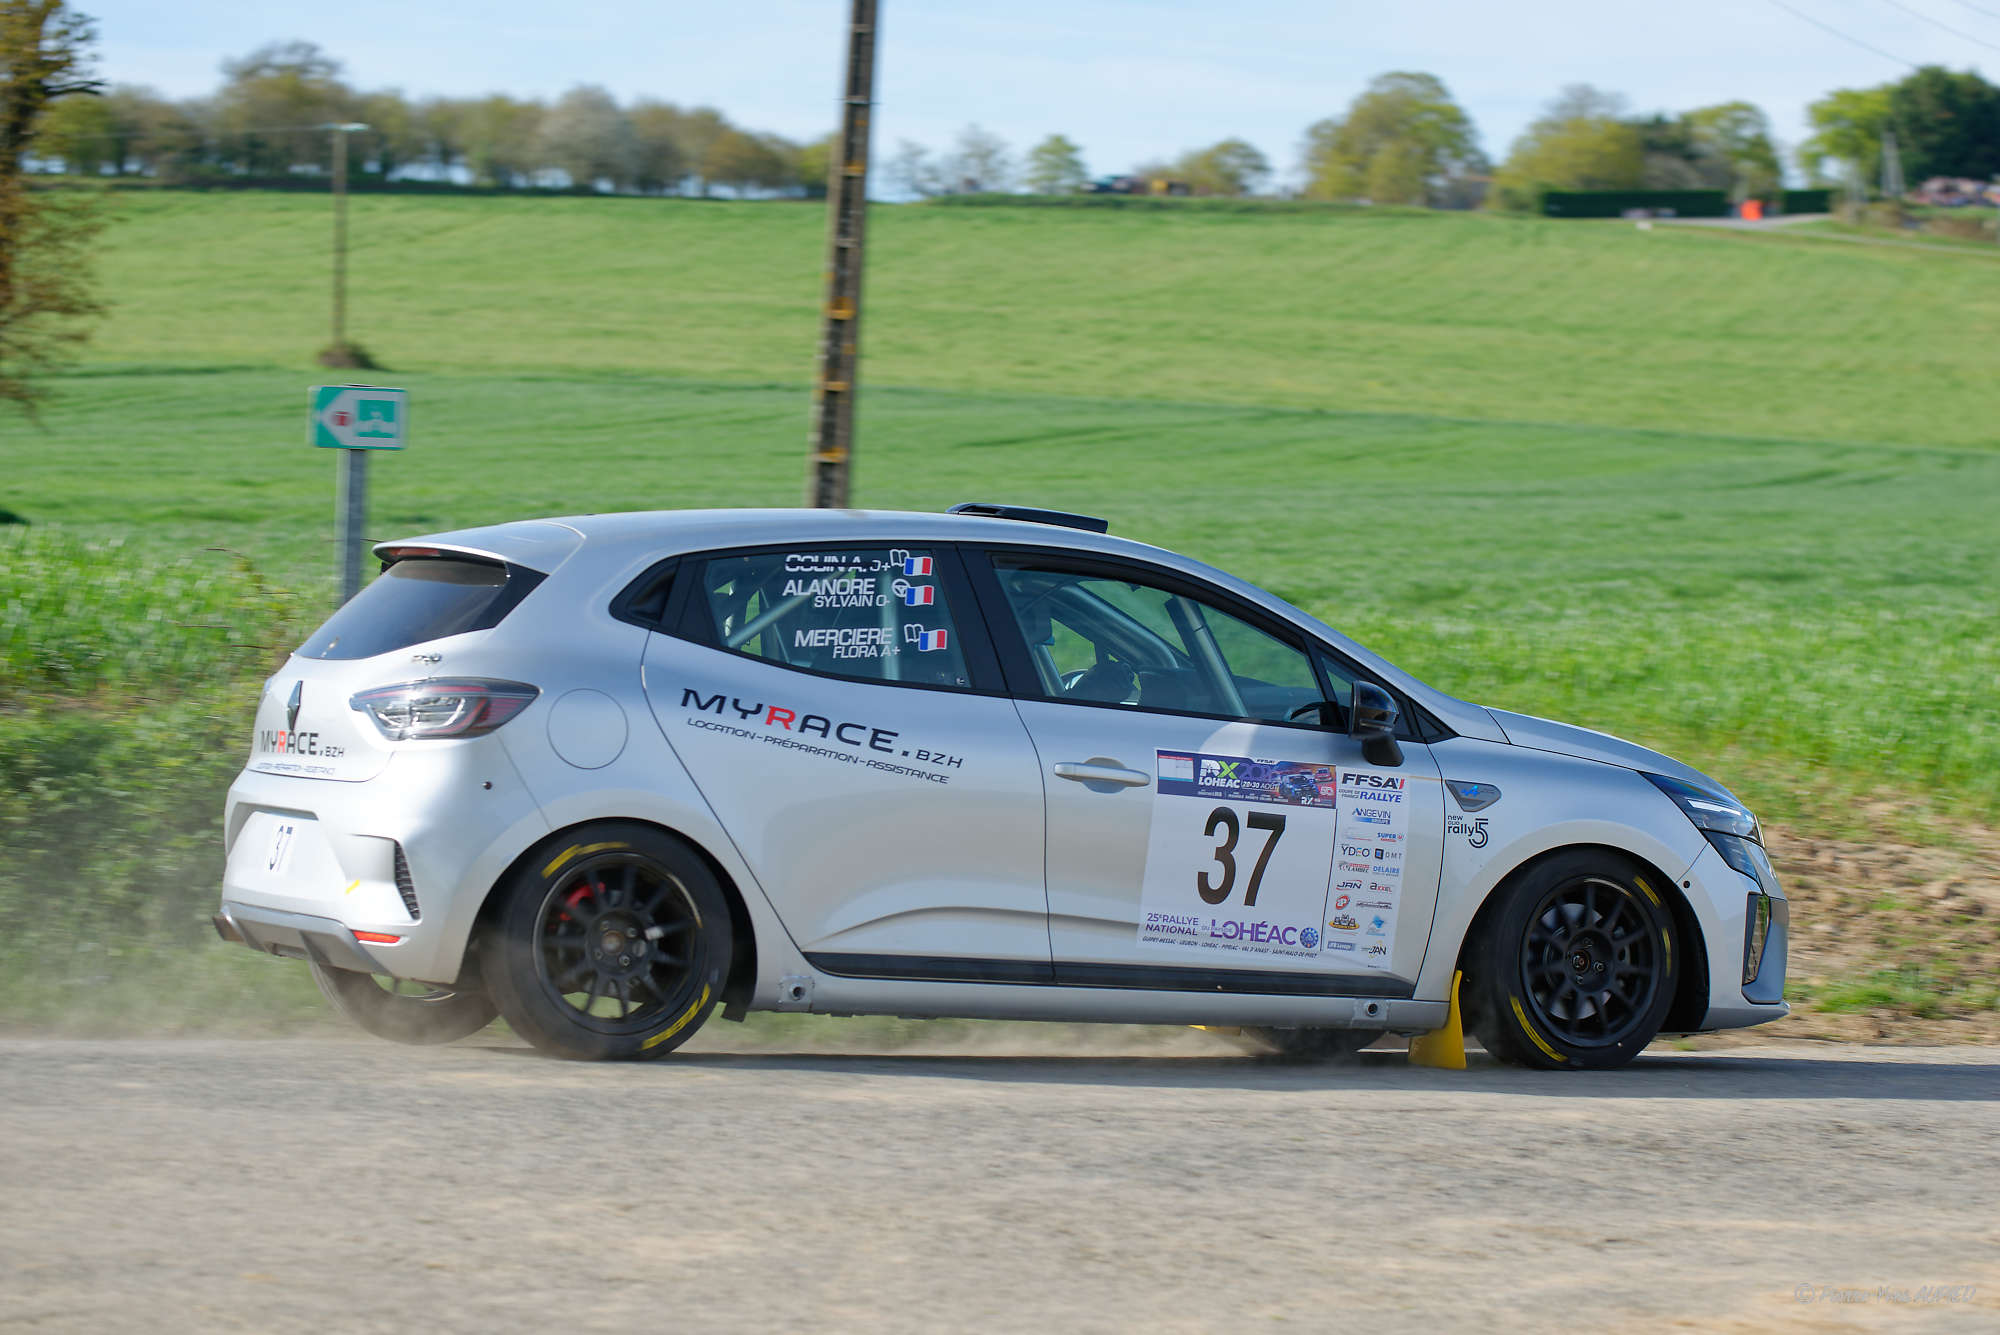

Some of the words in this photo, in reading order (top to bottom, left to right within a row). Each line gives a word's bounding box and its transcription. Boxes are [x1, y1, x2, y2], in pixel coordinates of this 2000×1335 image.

[782, 578, 876, 597] ALANORE
[814, 594, 874, 608] SYLVAIN
[794, 628, 892, 648] MERCIERE
[832, 645, 878, 659] FLORA
[1198, 777, 1241, 789] LOHEAC
[1342, 772, 1399, 790] FFSA
[1360, 791, 1402, 804] RALLYE
[1351, 807, 1392, 819] ANGEVIN
[1197, 806, 1287, 907] 37
[1162, 914, 1199, 926] RALLYE
[1145, 923, 1198, 936] NATIONAL
[1209, 919, 1297, 946] LOHÉAC
